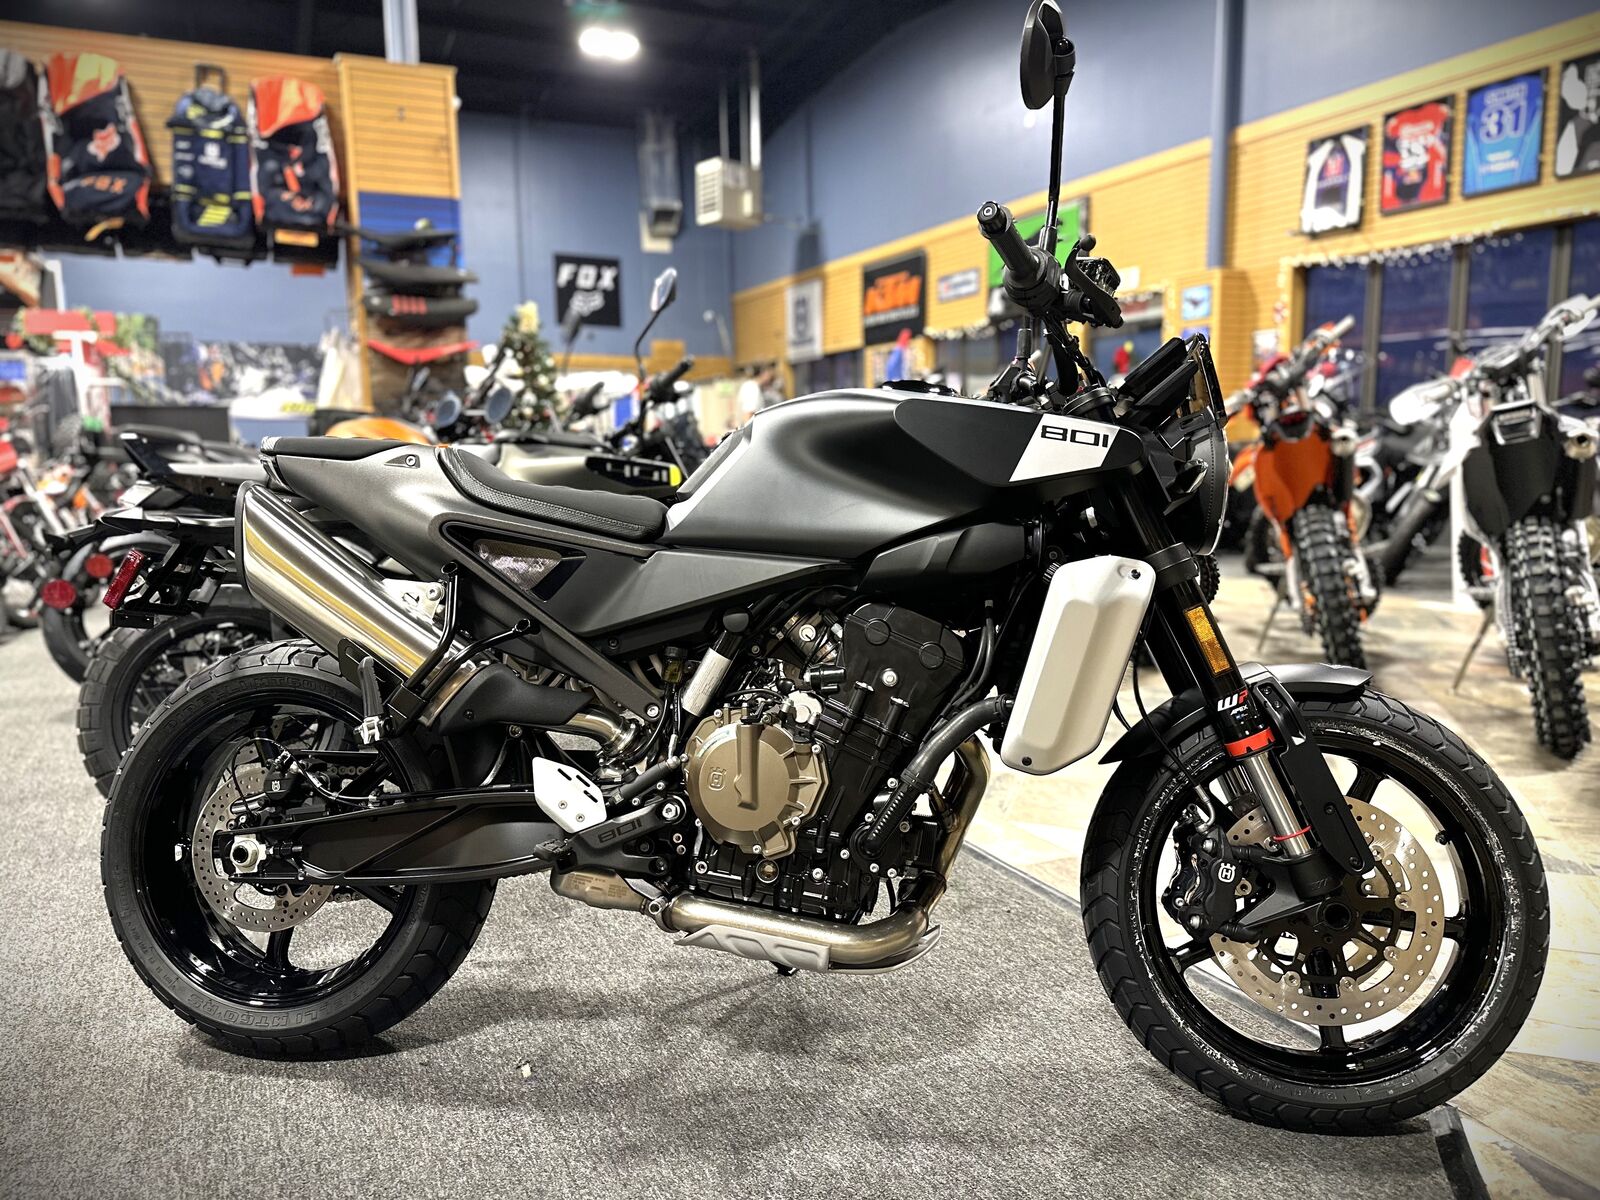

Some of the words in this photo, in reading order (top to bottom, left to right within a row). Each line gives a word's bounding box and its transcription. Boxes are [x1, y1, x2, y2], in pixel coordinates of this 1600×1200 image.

[557, 262, 618, 291] FOX
[1041, 424, 1109, 448] 801
[1217, 689, 1248, 712] WP
[598, 817, 642, 843] 801
